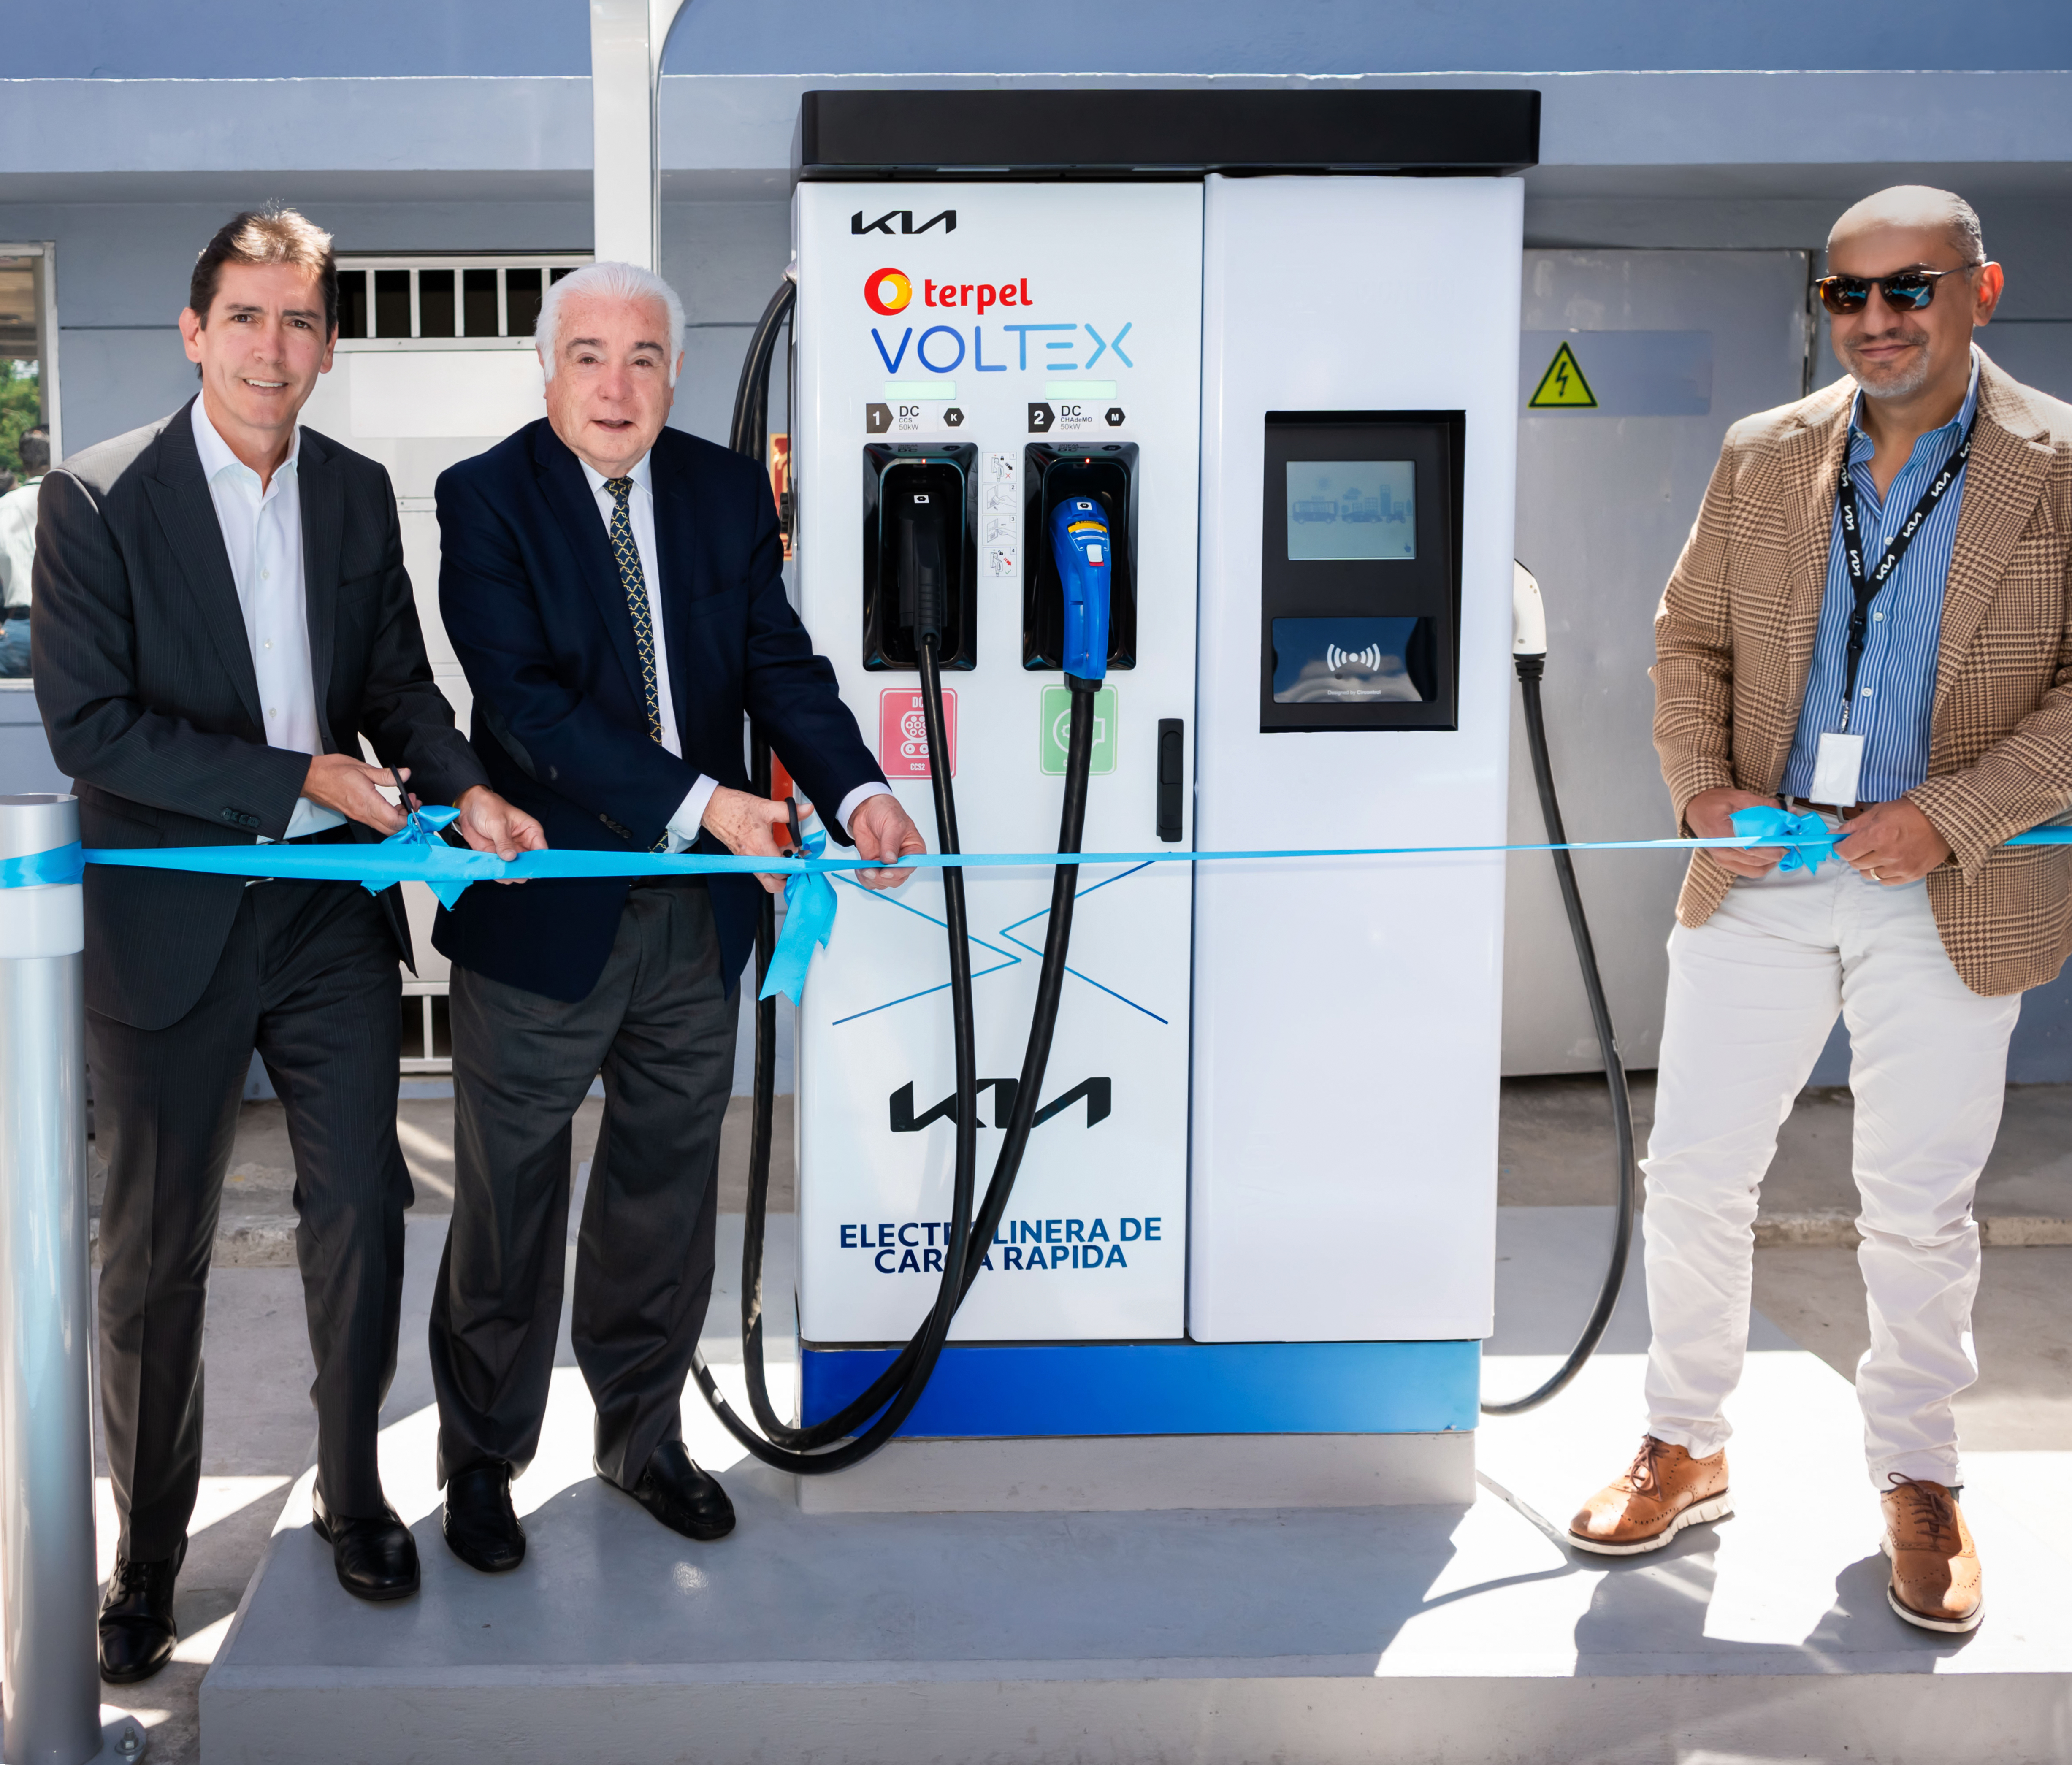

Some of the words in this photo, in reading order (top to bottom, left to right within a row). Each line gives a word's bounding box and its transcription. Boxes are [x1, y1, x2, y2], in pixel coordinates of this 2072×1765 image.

[851, 209, 957, 235] KIA
[924, 278, 1033, 315] terpel
[871, 322, 1133, 374] VOLTEX
[872, 411, 880, 425] 1
[899, 406, 919, 417] DC
[1034, 410, 1044, 425] 2
[1061, 405, 1081, 417] DC
[1111, 413, 1119, 421] M
[1931, 472, 1950, 497] KIA
[1844, 505, 1855, 531] KIA
[1903, 512, 1922, 537] KIA
[1850, 550, 1861, 577] KIA
[1876, 554, 1895, 580] KIA
[840, 1218, 1110, 1248] ELECTLINERA
[1120, 1217, 1162, 1242] DE
[875, 1248, 994, 1274] CARA
[1004, 1244, 1127, 1270] RAPIDA
